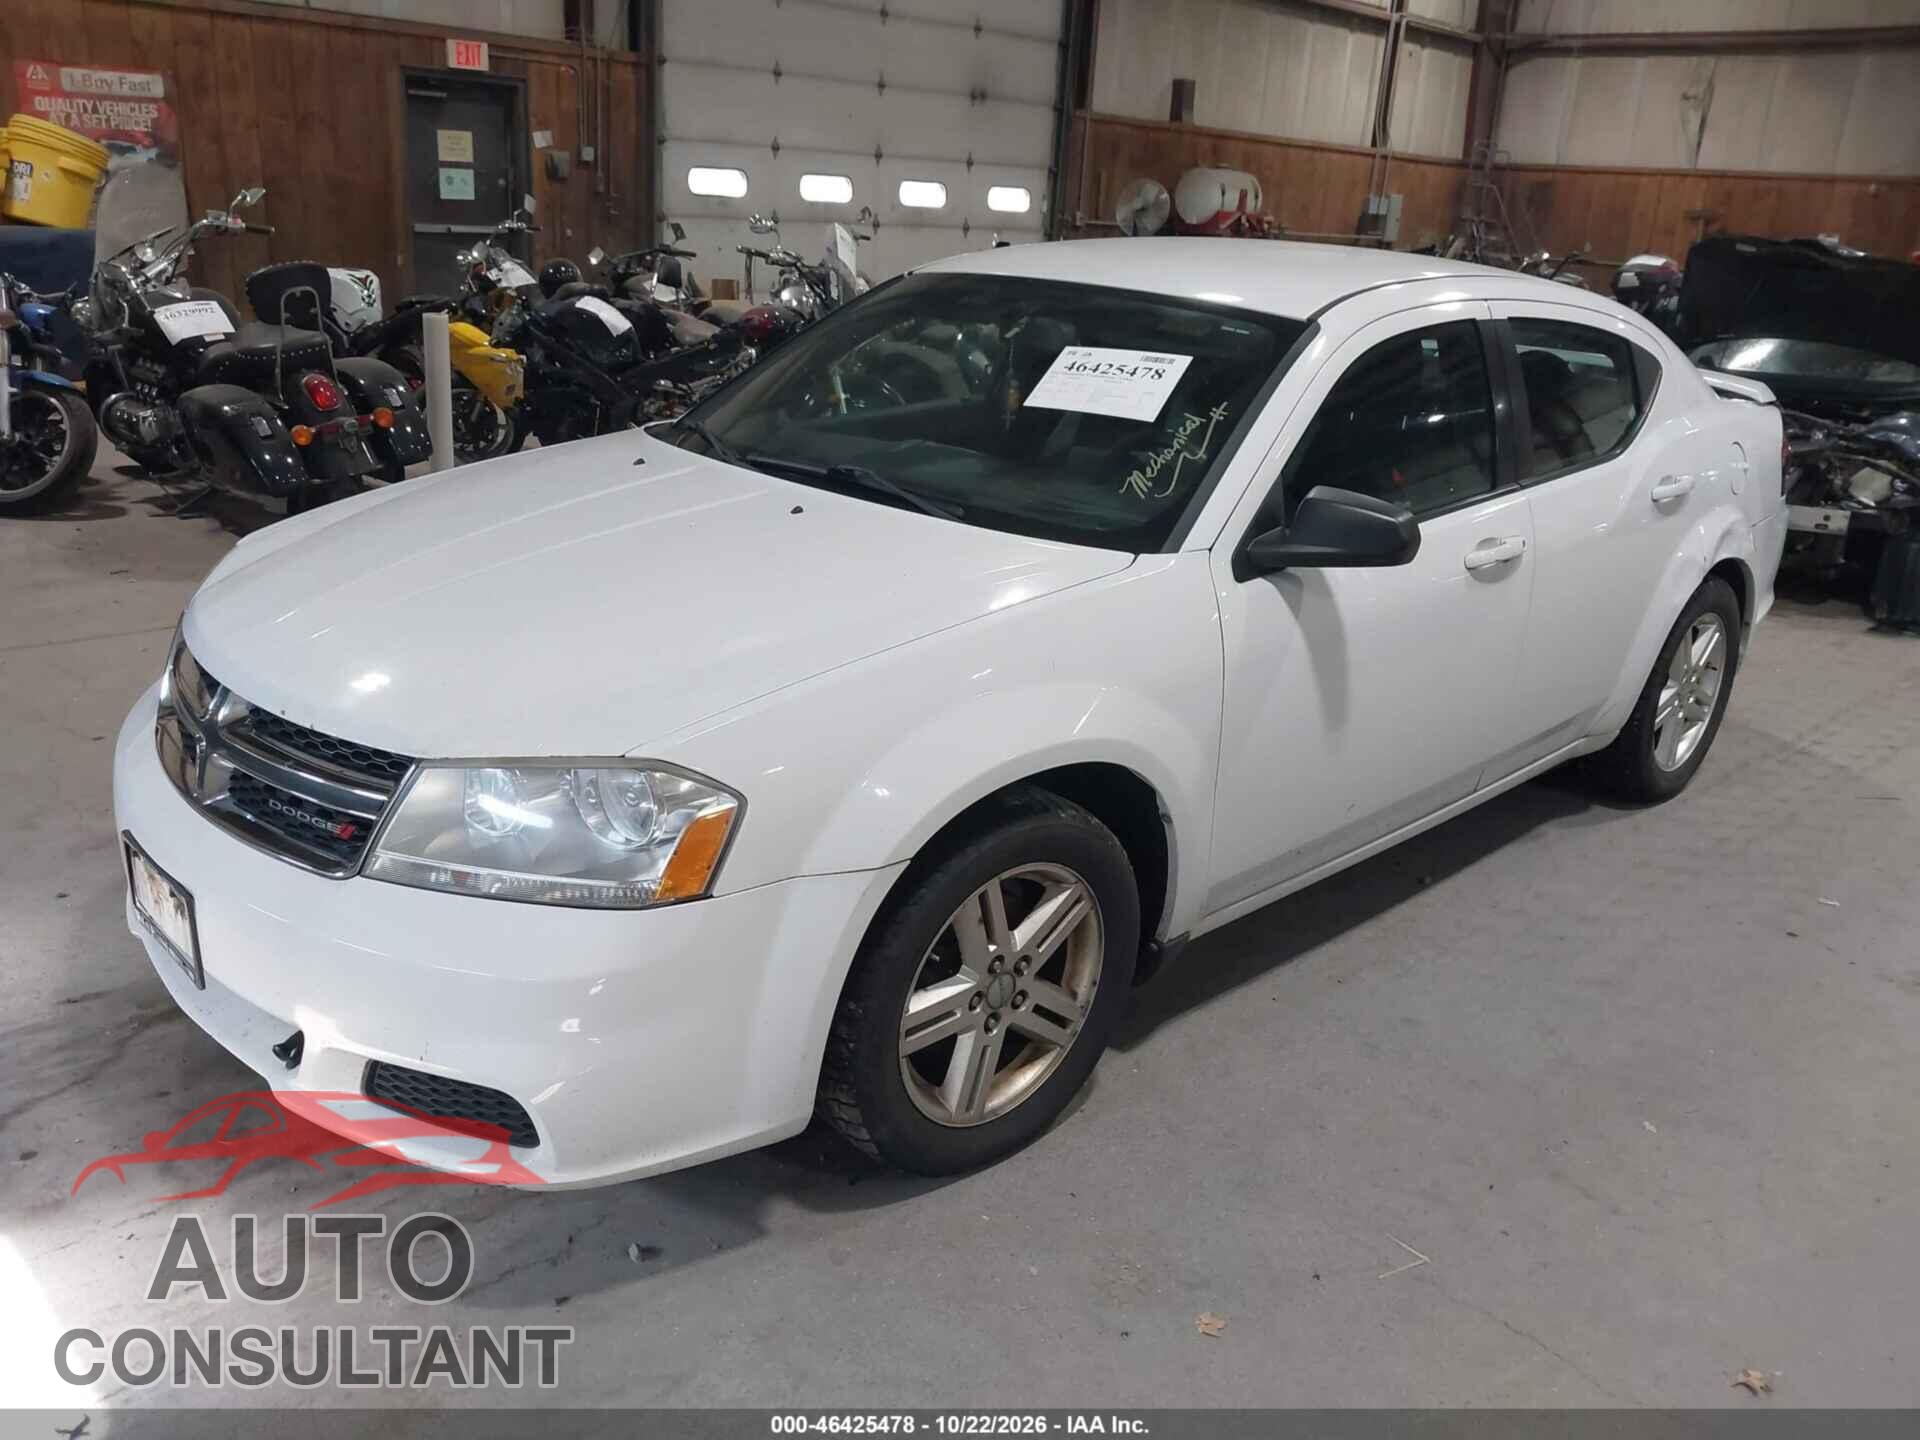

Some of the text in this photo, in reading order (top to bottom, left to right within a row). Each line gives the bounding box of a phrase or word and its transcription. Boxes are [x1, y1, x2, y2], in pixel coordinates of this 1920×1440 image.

[456, 43, 480, 66] EXIT
[119, 75, 152, 94] Fast
[34, 96, 159, 118] QUALITY VEHICLES
[70, 113, 81, 128] A
[84, 115, 109, 129] SET
[1063, 360, 1166, 381] 46425478
[1119, 412, 1207, 499] Mechanical
[269, 799, 341, 834] DODGE
